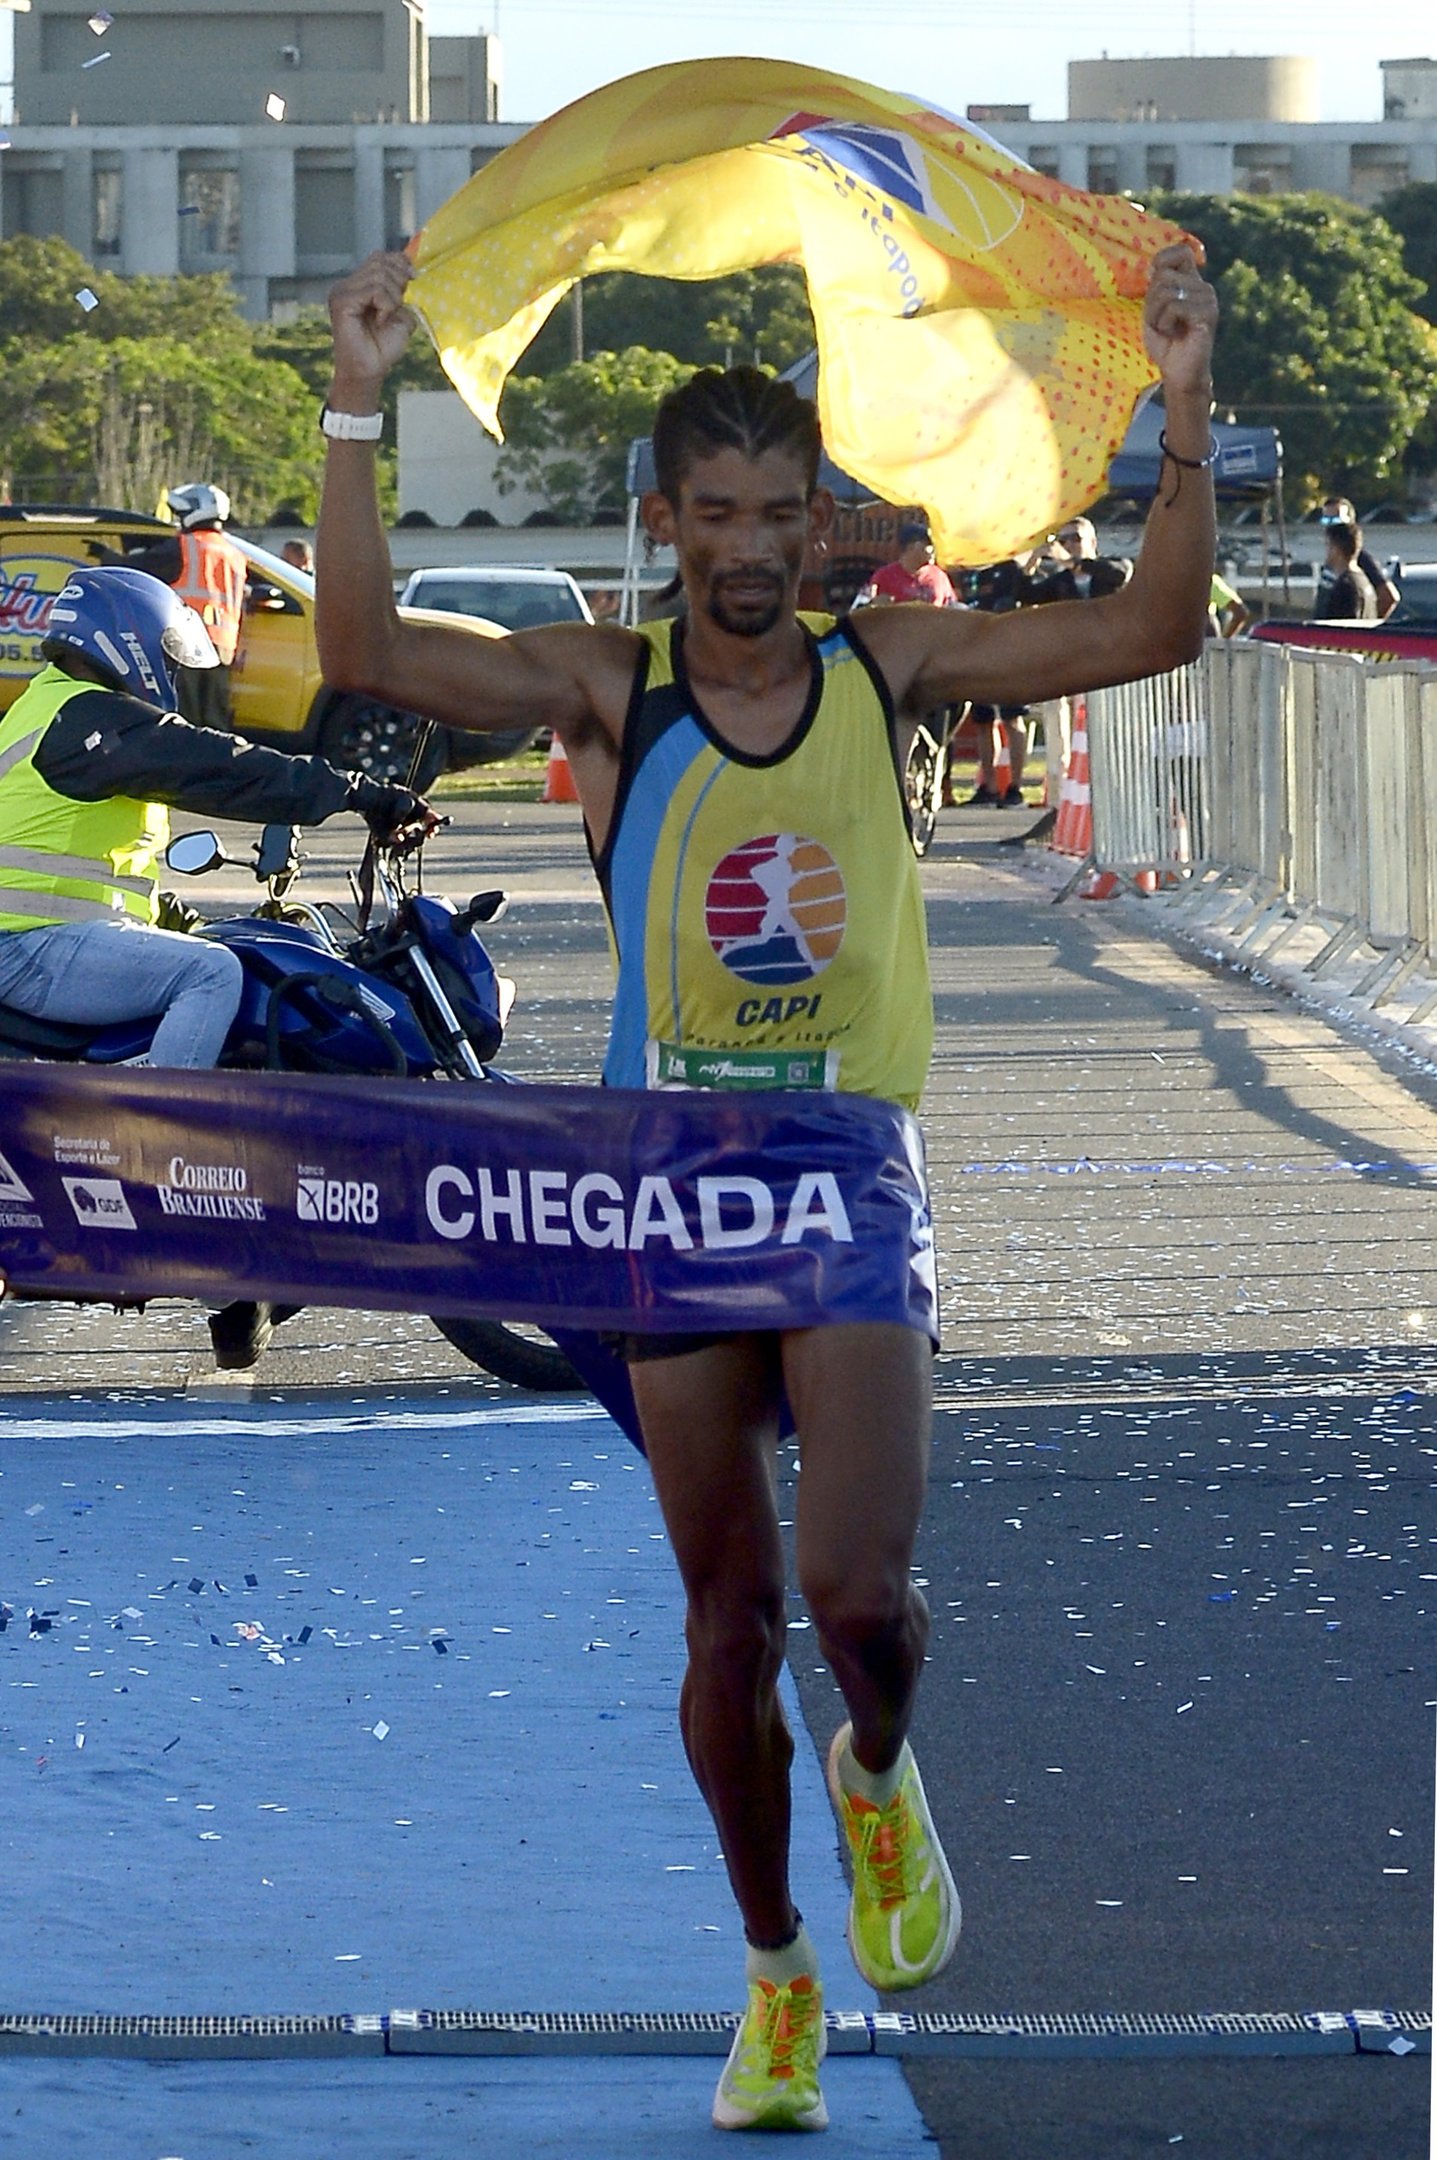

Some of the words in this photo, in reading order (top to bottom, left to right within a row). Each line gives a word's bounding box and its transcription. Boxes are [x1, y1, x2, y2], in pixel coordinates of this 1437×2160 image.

[120, 632, 161, 696] HELT
[736, 993, 822, 1027] CAPI
[297, 1164, 325, 1176] banco
[98, 1198, 124, 1213] GDF
[325, 1180, 379, 1224] BRB
[425, 1165, 853, 1250] CHEGADA
